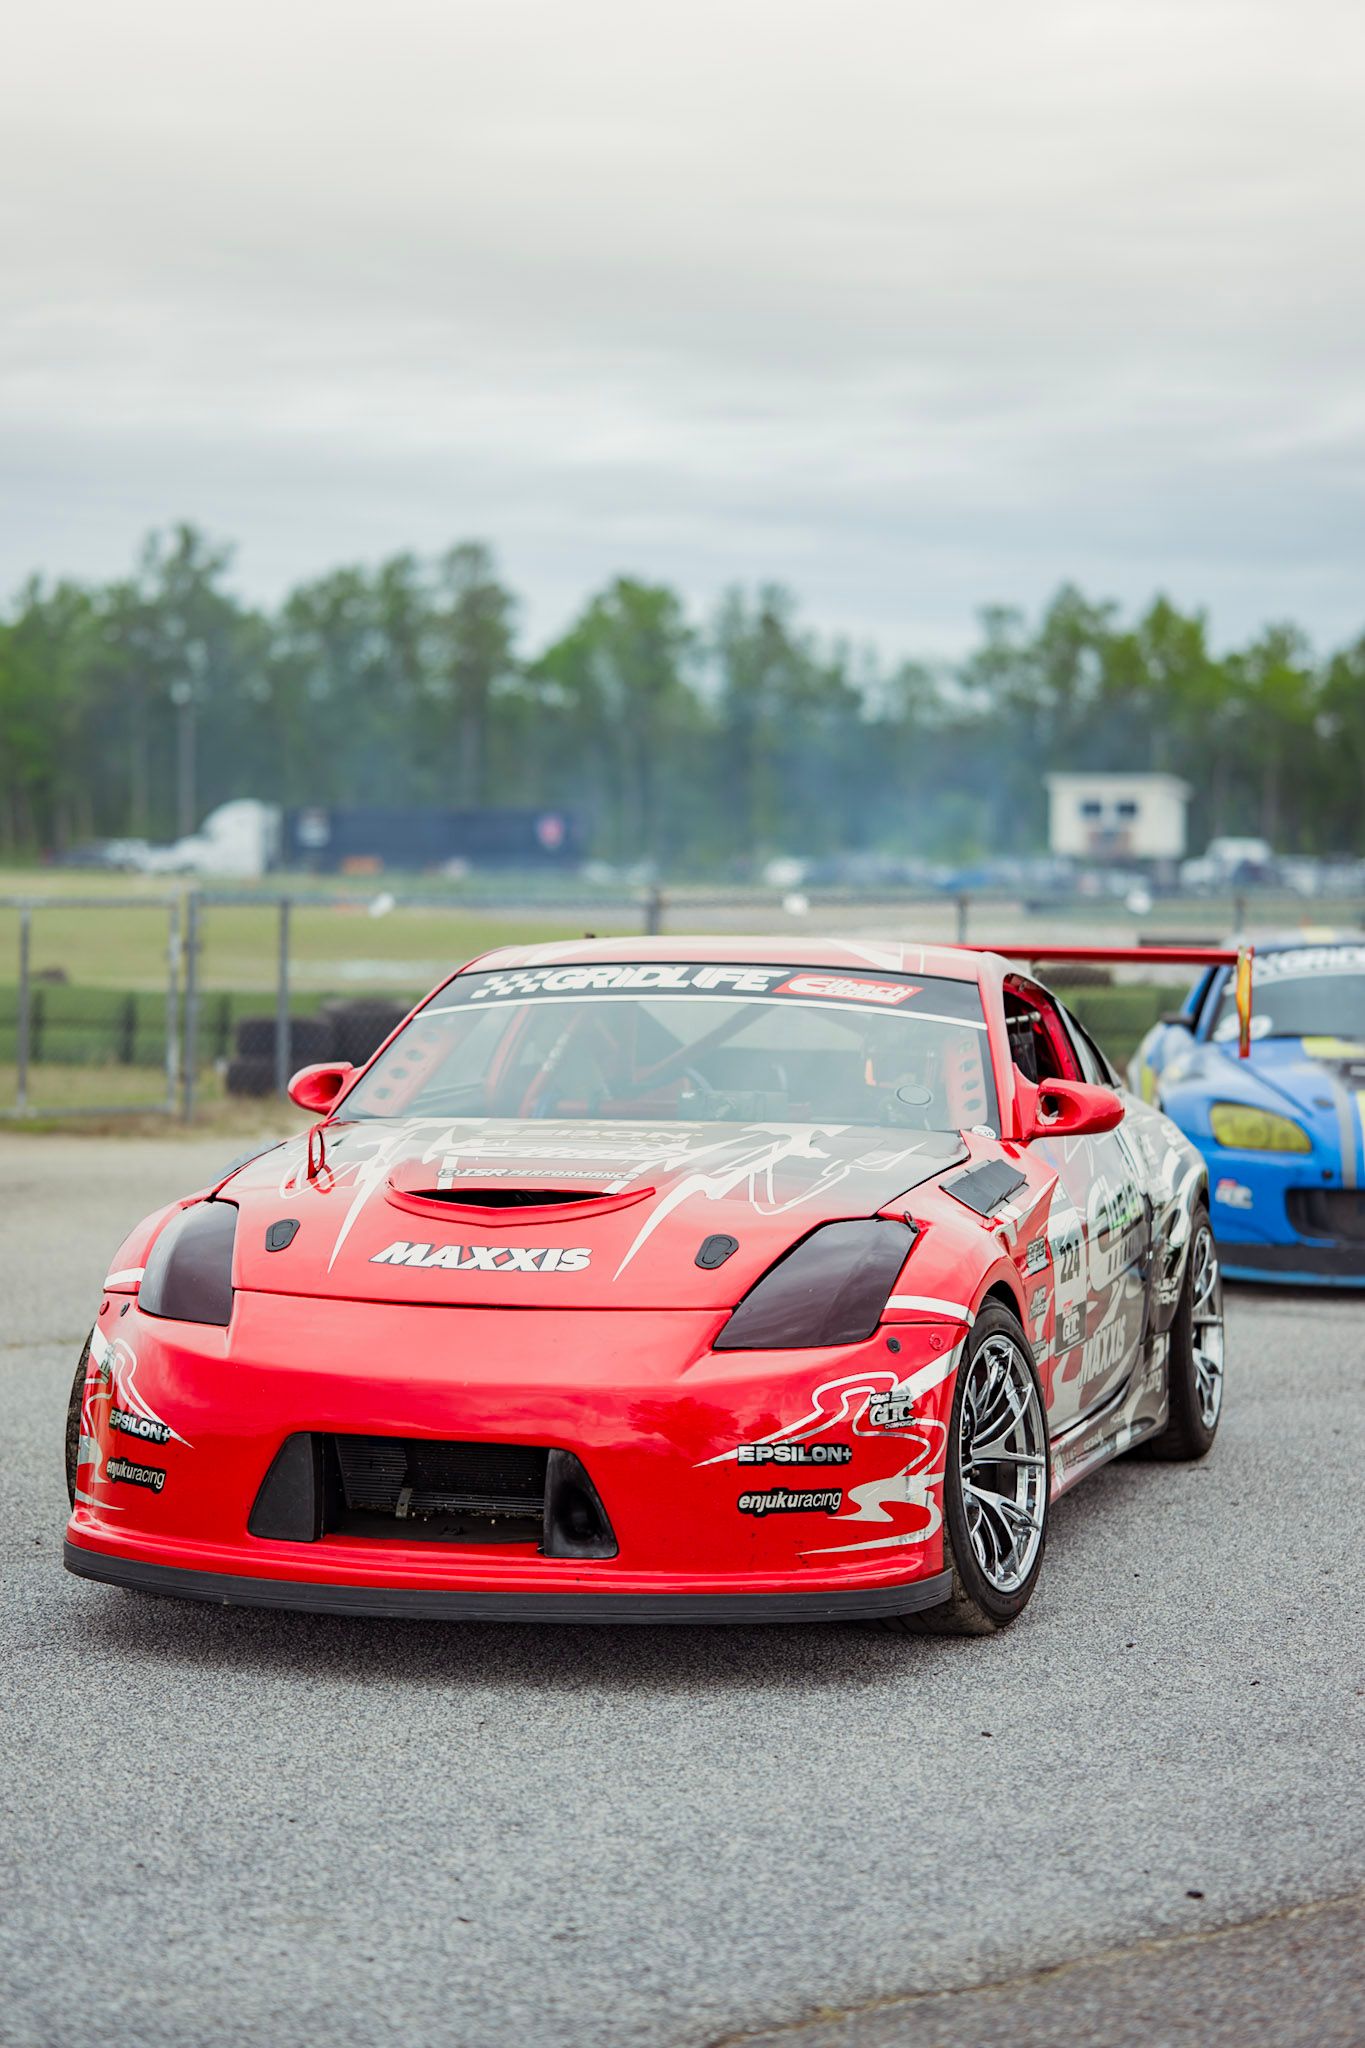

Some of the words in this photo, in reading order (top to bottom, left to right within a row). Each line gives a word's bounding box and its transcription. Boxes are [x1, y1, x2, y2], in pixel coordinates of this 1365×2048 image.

[541, 967, 790, 992] GRIDLIFE
[476, 1129, 692, 1139] SEIBON
[456, 1168, 508, 1177] ISR
[508, 1169, 640, 1181] PERFORMANCE
[369, 1241, 593, 1272] MAXXIS
[1060, 1239, 1080, 1283] 224
[1079, 1313, 1126, 1389] MAXXIS
[110, 1409, 171, 1441] EPSILON+
[737, 1445, 852, 1462] EPSILON+
[106, 1460, 165, 1489] enjukuracing
[738, 1491, 842, 1513] enjukuracing
